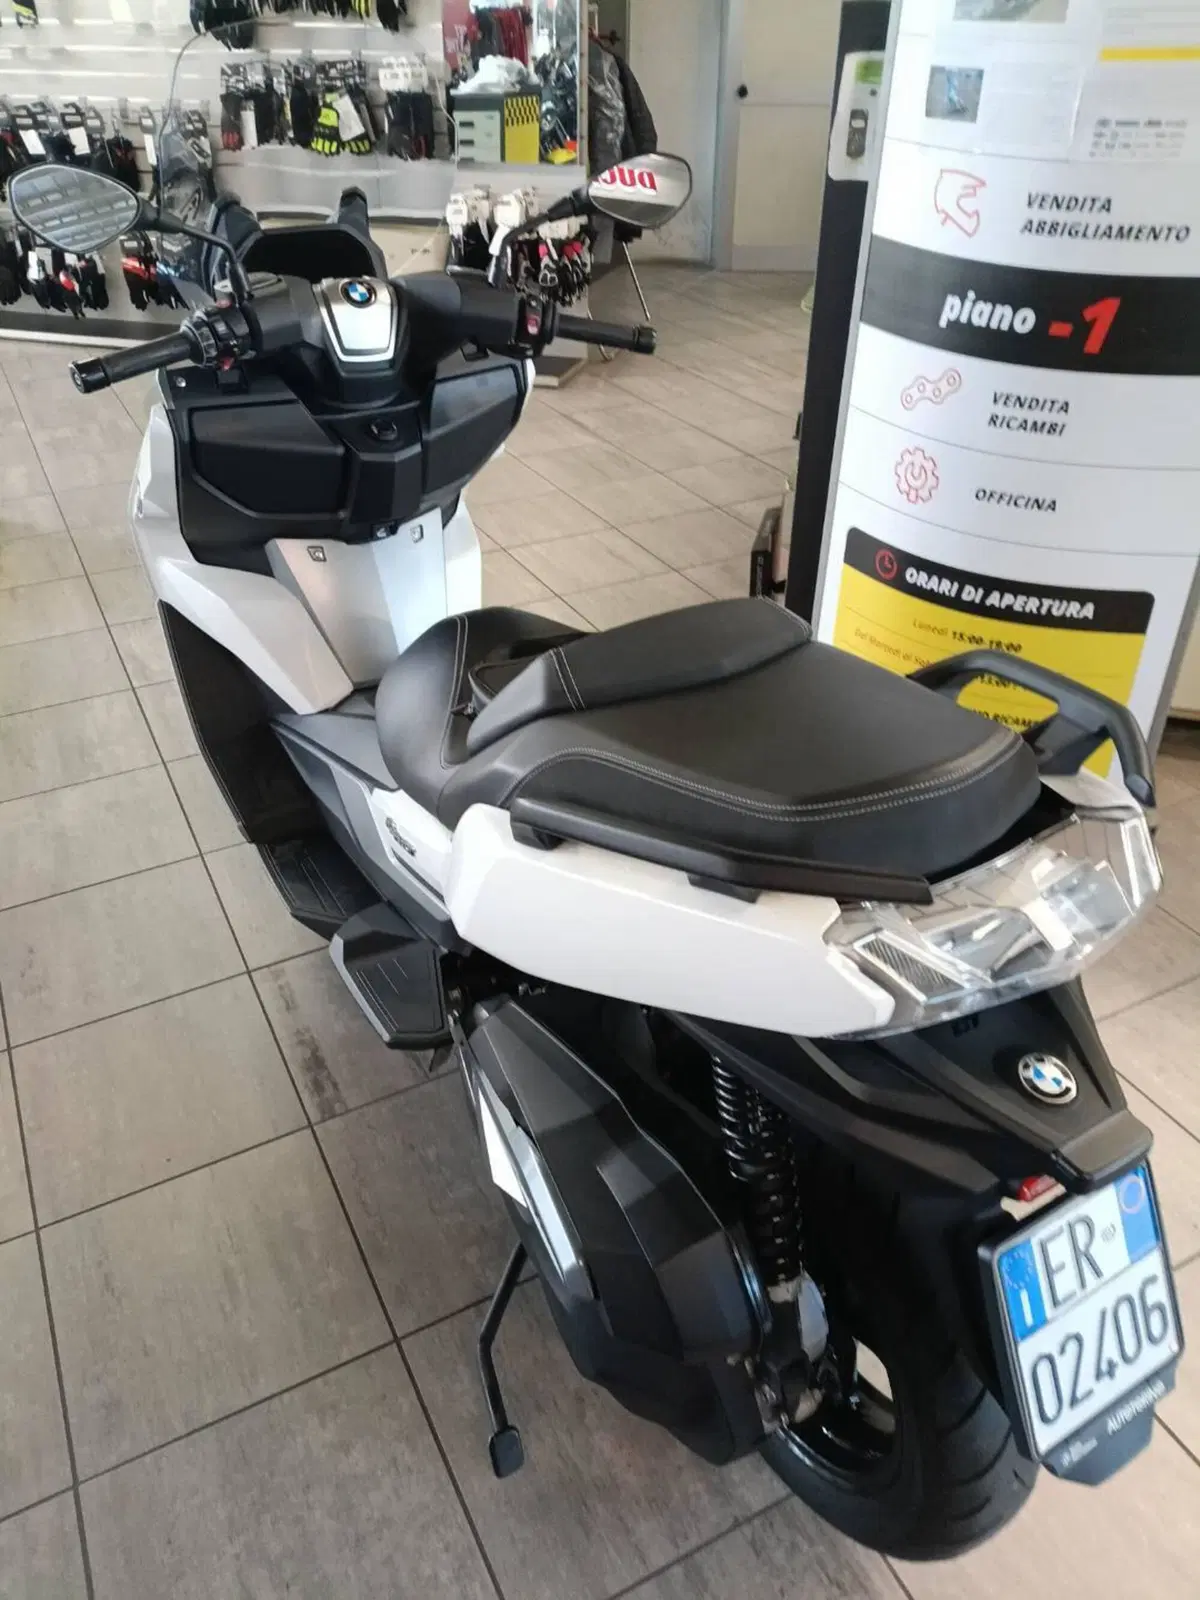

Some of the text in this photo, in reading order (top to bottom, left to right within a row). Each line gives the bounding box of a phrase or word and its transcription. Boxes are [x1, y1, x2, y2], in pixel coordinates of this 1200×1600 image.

[1027, 192, 1112, 214] VENDITA
[1020, 218, 1192, 243] ABBIGLIAMENTO
[938, 289, 1121, 355] piano -1
[992, 391, 1071, 415] VENDITA
[988, 413, 1067, 437] RICAMBI
[975, 487, 1058, 512] OFFICINA
[905, 566, 1096, 620] ORARI DI APERTURA
[1039, 1212, 1104, 1309] ER
[1031, 1274, 1170, 1425] 02406
